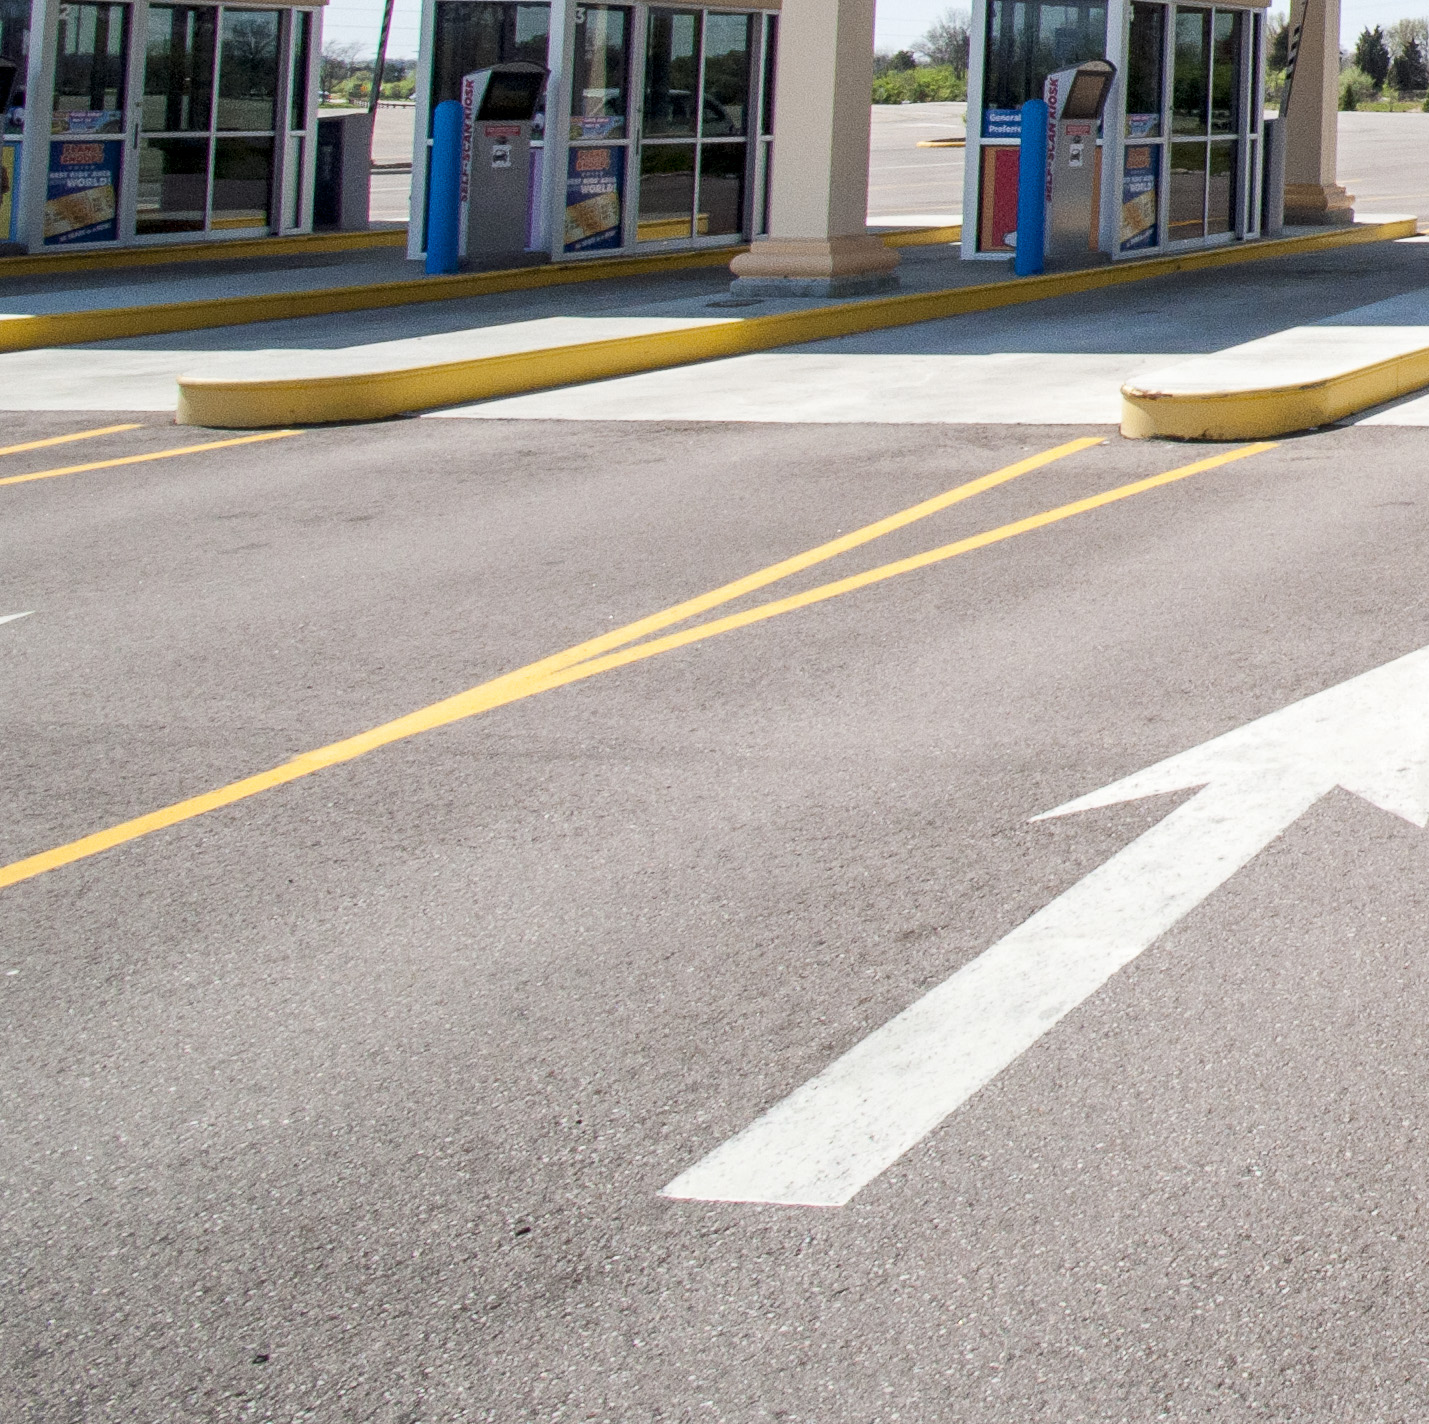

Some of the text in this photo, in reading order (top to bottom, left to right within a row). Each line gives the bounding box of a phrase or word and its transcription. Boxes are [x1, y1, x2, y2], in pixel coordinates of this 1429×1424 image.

[60, 4, 71, 21] 2
[575, 7, 586, 24] 3
[990, 114, 1021, 122] General
[461, 79, 475, 202] SELF-SCAN KIOSK
[1046, 78, 1059, 201] SELF-SCAN KIOSK
